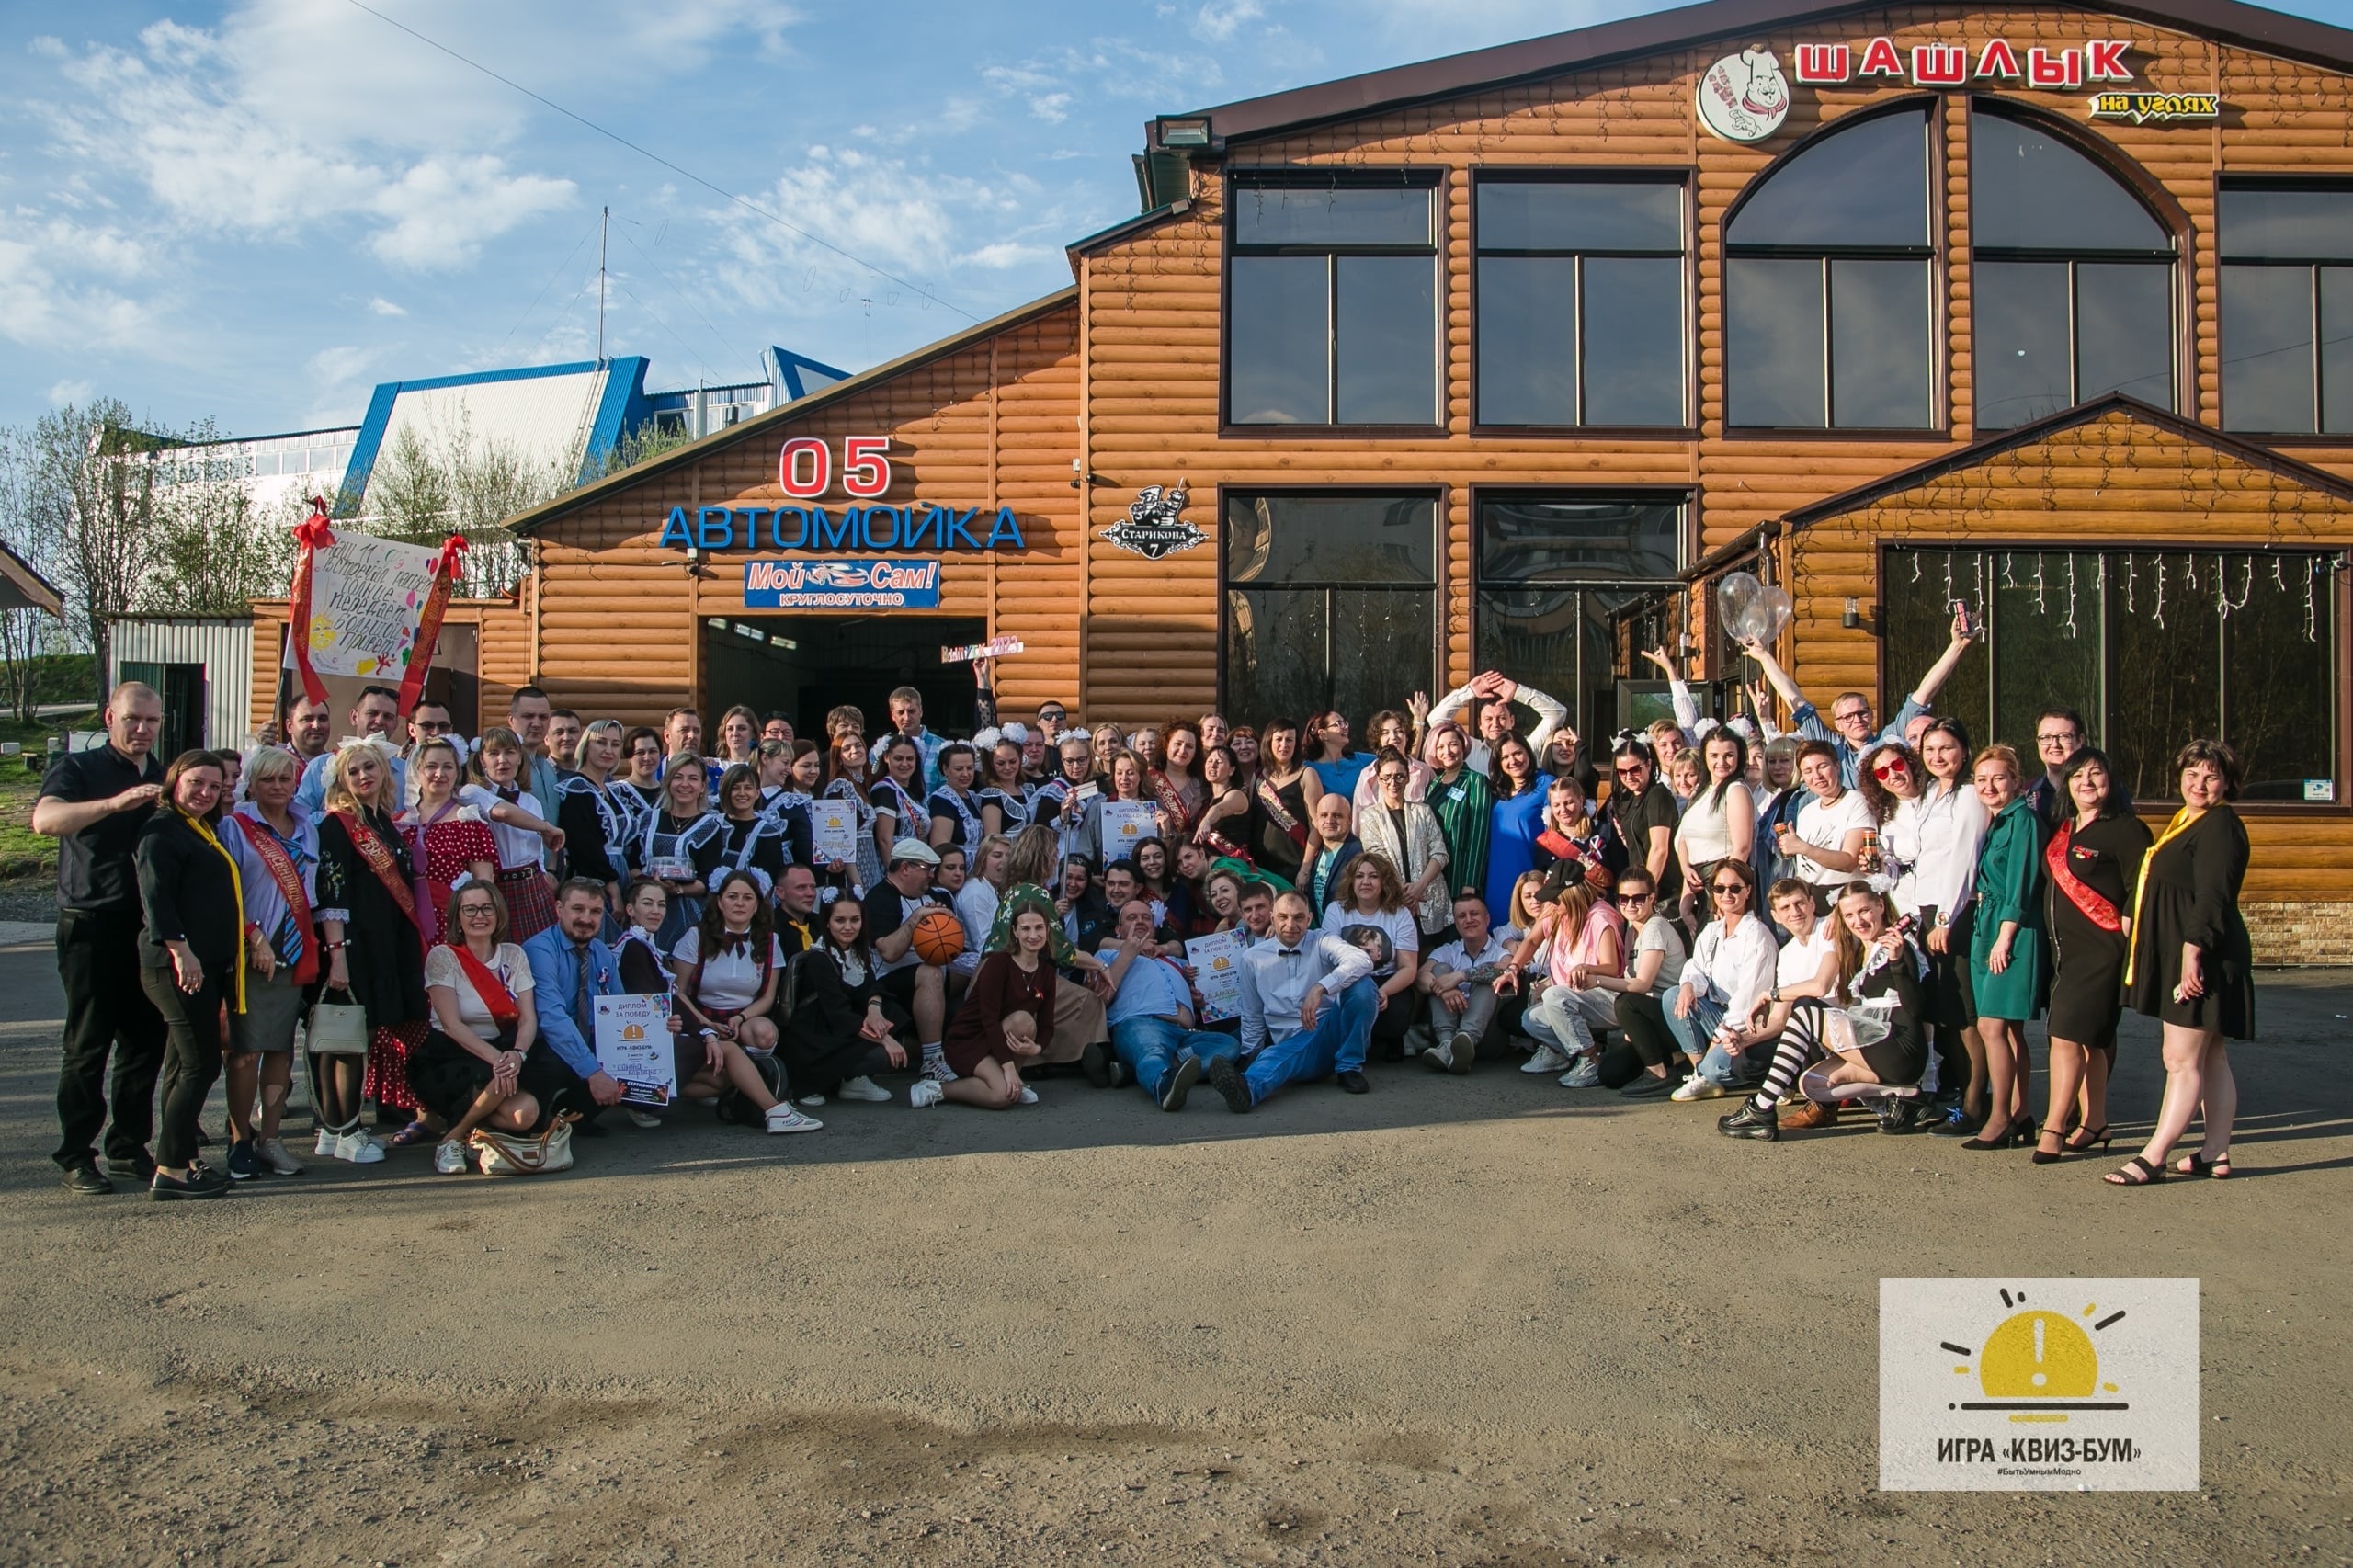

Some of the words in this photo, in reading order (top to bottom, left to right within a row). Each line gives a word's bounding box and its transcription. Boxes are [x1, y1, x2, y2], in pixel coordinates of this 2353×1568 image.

[1795, 37, 2132, 89] ШАШЛЫК
[2100, 95, 2129, 110] на
[2138, 96, 2214, 115] углях
[659, 502, 1025, 550] АВТОМОЙКА
[1149, 543, 1159, 557] 7
[747, 562, 806, 590] Мой
[871, 562, 936, 589] Сам!
[779, 592, 904, 607] КРУГЛОСУТОЧНО
